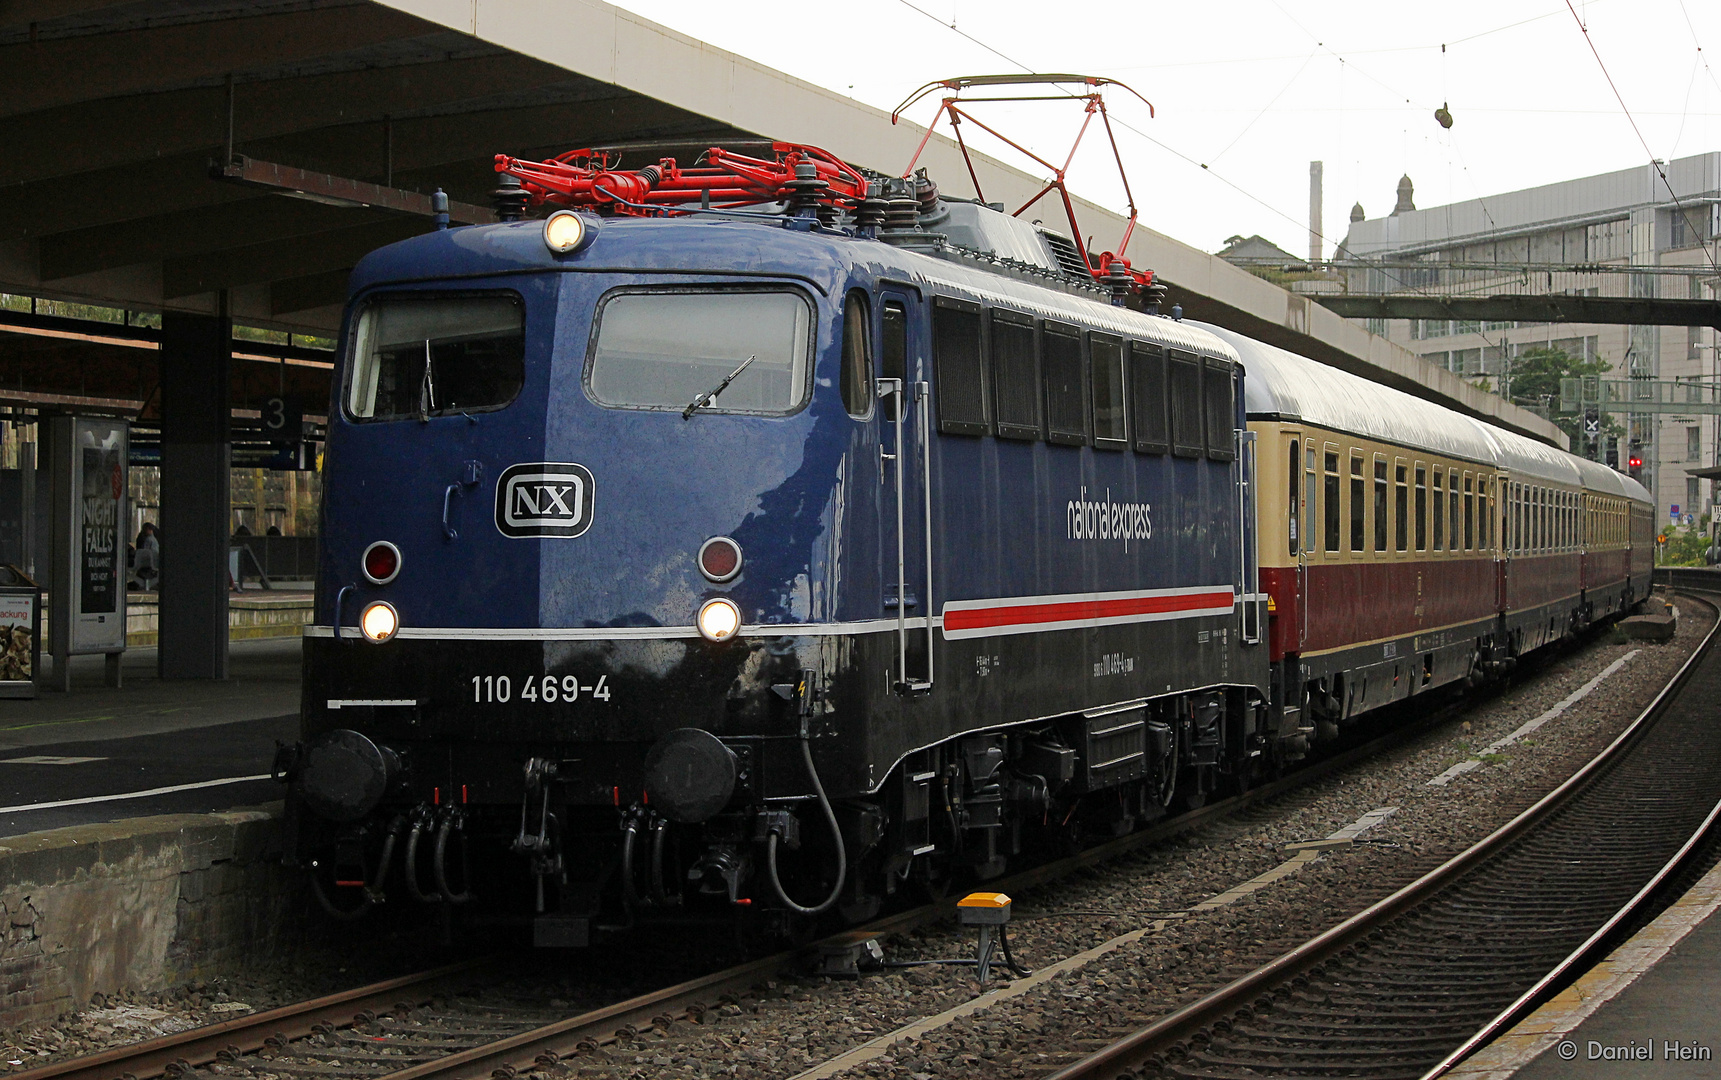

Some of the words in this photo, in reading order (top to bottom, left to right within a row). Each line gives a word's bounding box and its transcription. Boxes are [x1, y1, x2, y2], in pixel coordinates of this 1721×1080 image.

[266, 398, 286, 429] 3
[289, 450, 295, 460] 4
[83, 498, 116, 526] NIGHT
[513, 485, 573, 516] NX
[85, 527, 114, 553] FALLS
[0, 610, 28, 620] ackung
[471, 674, 512, 703] 110
[521, 674, 611, 703] 469-4
